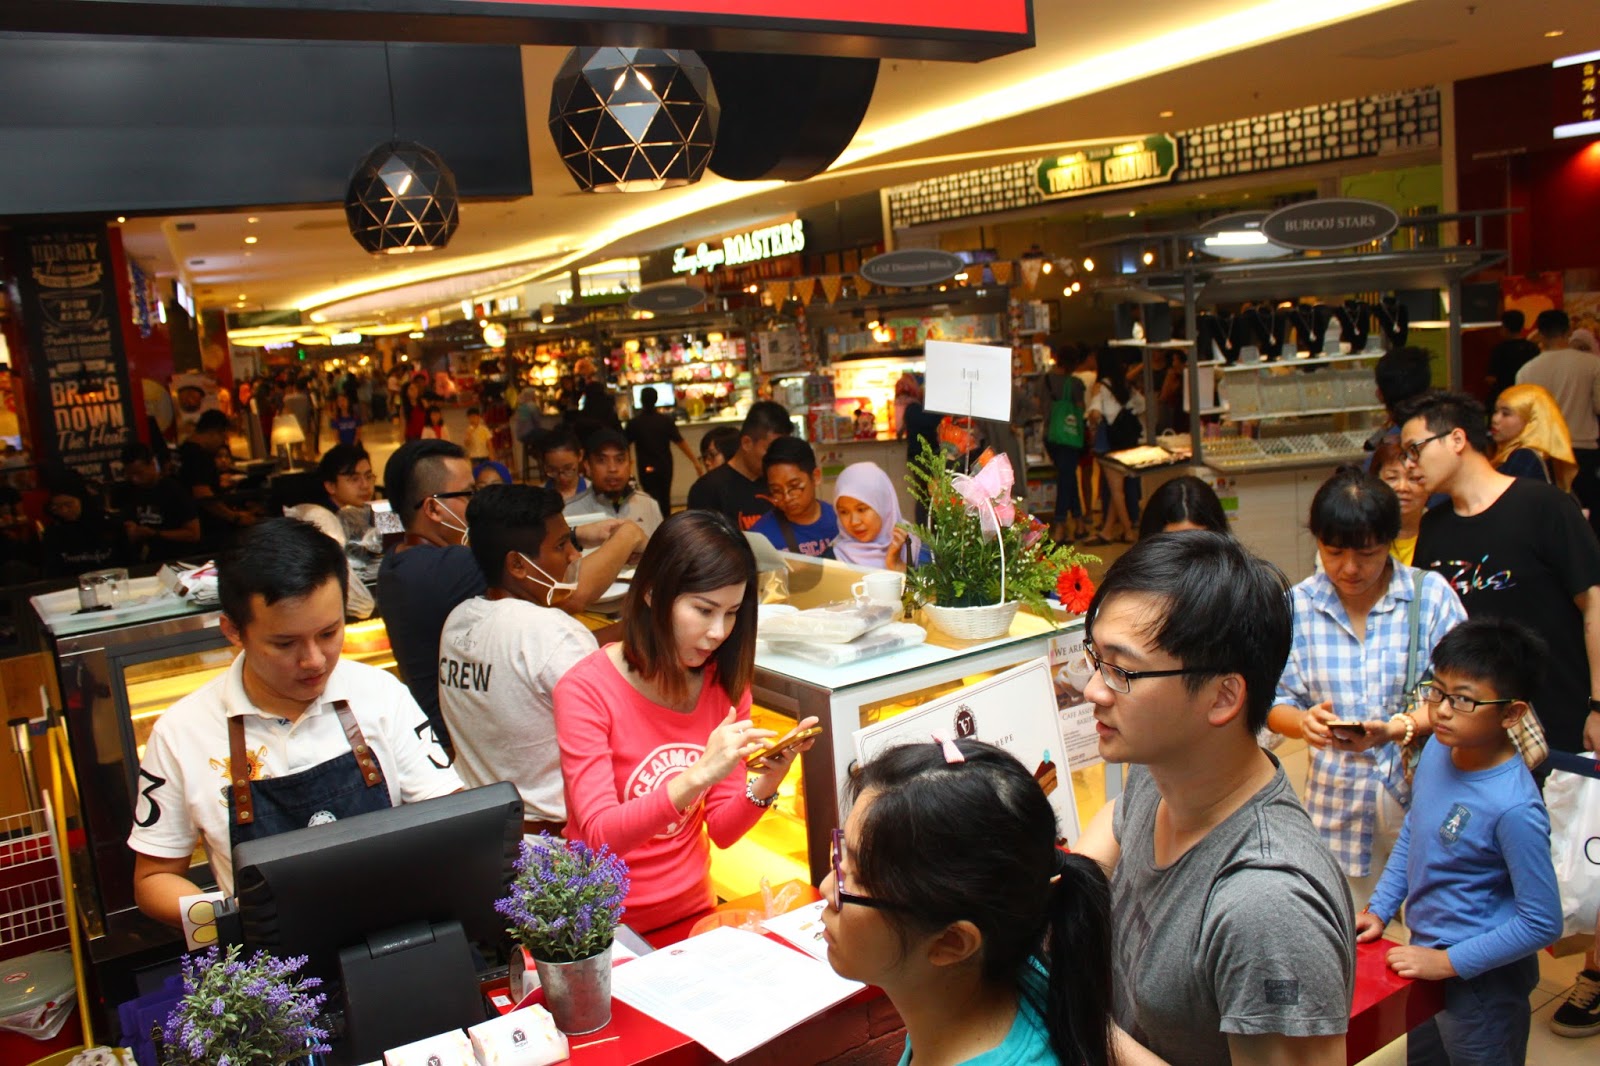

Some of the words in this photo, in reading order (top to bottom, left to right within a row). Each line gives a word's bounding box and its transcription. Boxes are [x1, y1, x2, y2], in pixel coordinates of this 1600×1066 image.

[1285, 217, 1335, 232] BUROOJ
[1337, 214, 1376, 228] STARS
[722, 219, 804, 265] ROASTERS
[54, 402, 124, 432] DOWN
[1054, 647, 1067, 657] WE
[1069, 643, 1083, 655] ARE
[440, 657, 492, 692] CREW
[414, 720, 456, 770] 3
[992, 733, 1014, 748] REPE
[134, 768, 166, 828] 3
